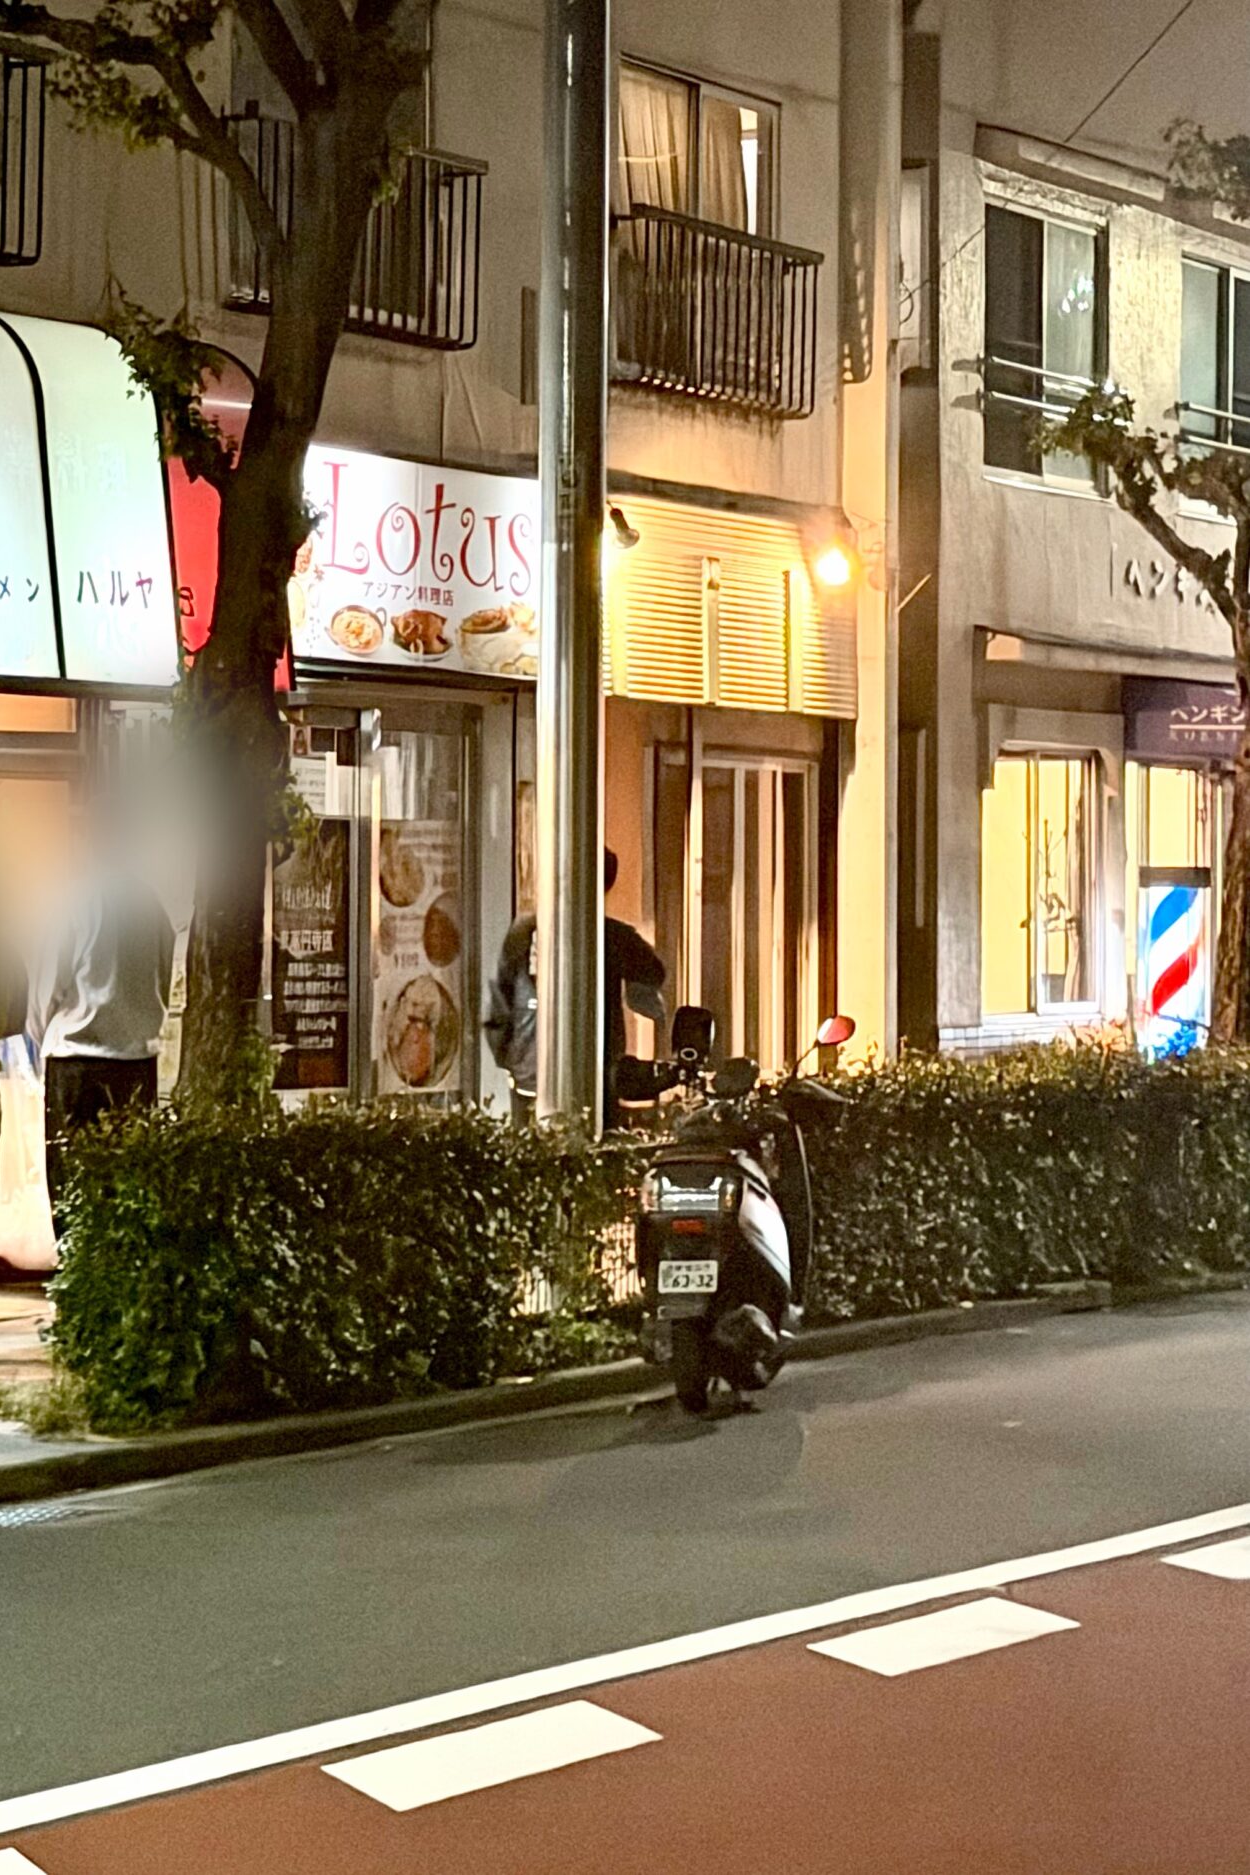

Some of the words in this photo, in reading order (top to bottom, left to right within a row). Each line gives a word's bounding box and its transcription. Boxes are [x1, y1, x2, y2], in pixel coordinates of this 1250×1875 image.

[322, 460, 533, 597] Lotus
[76, 570, 154, 609] ハルヤ
[362, 581, 455, 607] アジアン料理店
